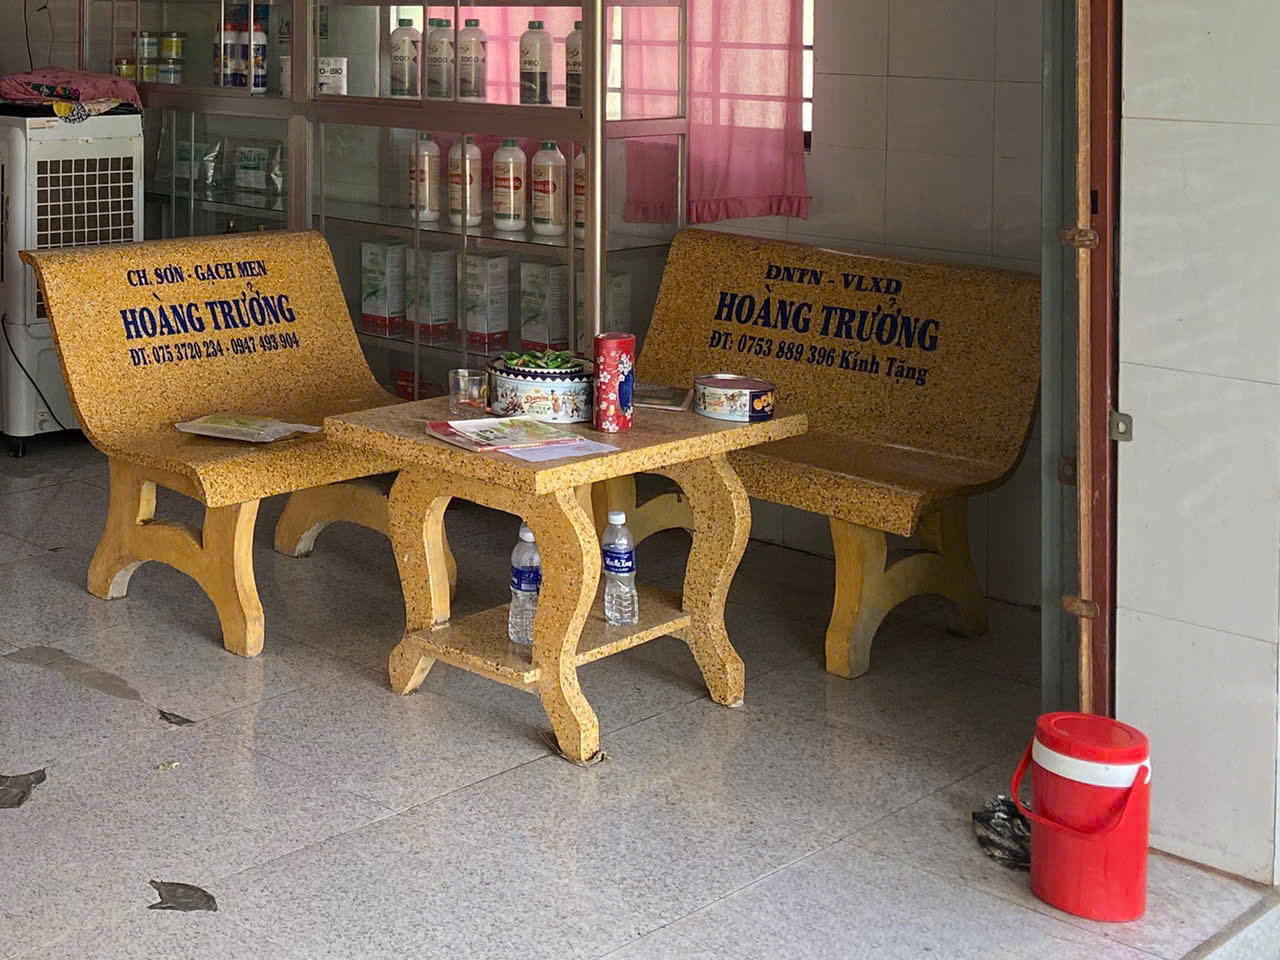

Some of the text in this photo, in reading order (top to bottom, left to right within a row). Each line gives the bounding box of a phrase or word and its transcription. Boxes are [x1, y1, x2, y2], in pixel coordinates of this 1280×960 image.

[127, 269, 153, 287] CH.
[154, 264, 185, 284] SƠN
[195, 262, 236, 286] GẠCH
[238, 260, 268, 280] MEN
[121, 282, 296, 340] HOÀNG TRƯỞNG
[714, 284, 940, 351] HOÀNG TRƯỞNG
[129, 347, 151, 367] ĐT:
[152, 344, 173, 364] 075
[175, 341, 202, 361] 3720
[203, 339, 224, 359] 234
[232, 337, 257, 357] 0947
[259, 335, 278, 354] 493
[279, 332, 300, 351] 904
[737, 334, 772, 357] 0753
[775, 341, 804, 363] 889
[807, 346, 835, 367] 396
[838, 349, 880, 375] Kính
[885, 357, 929, 386] Tặng
